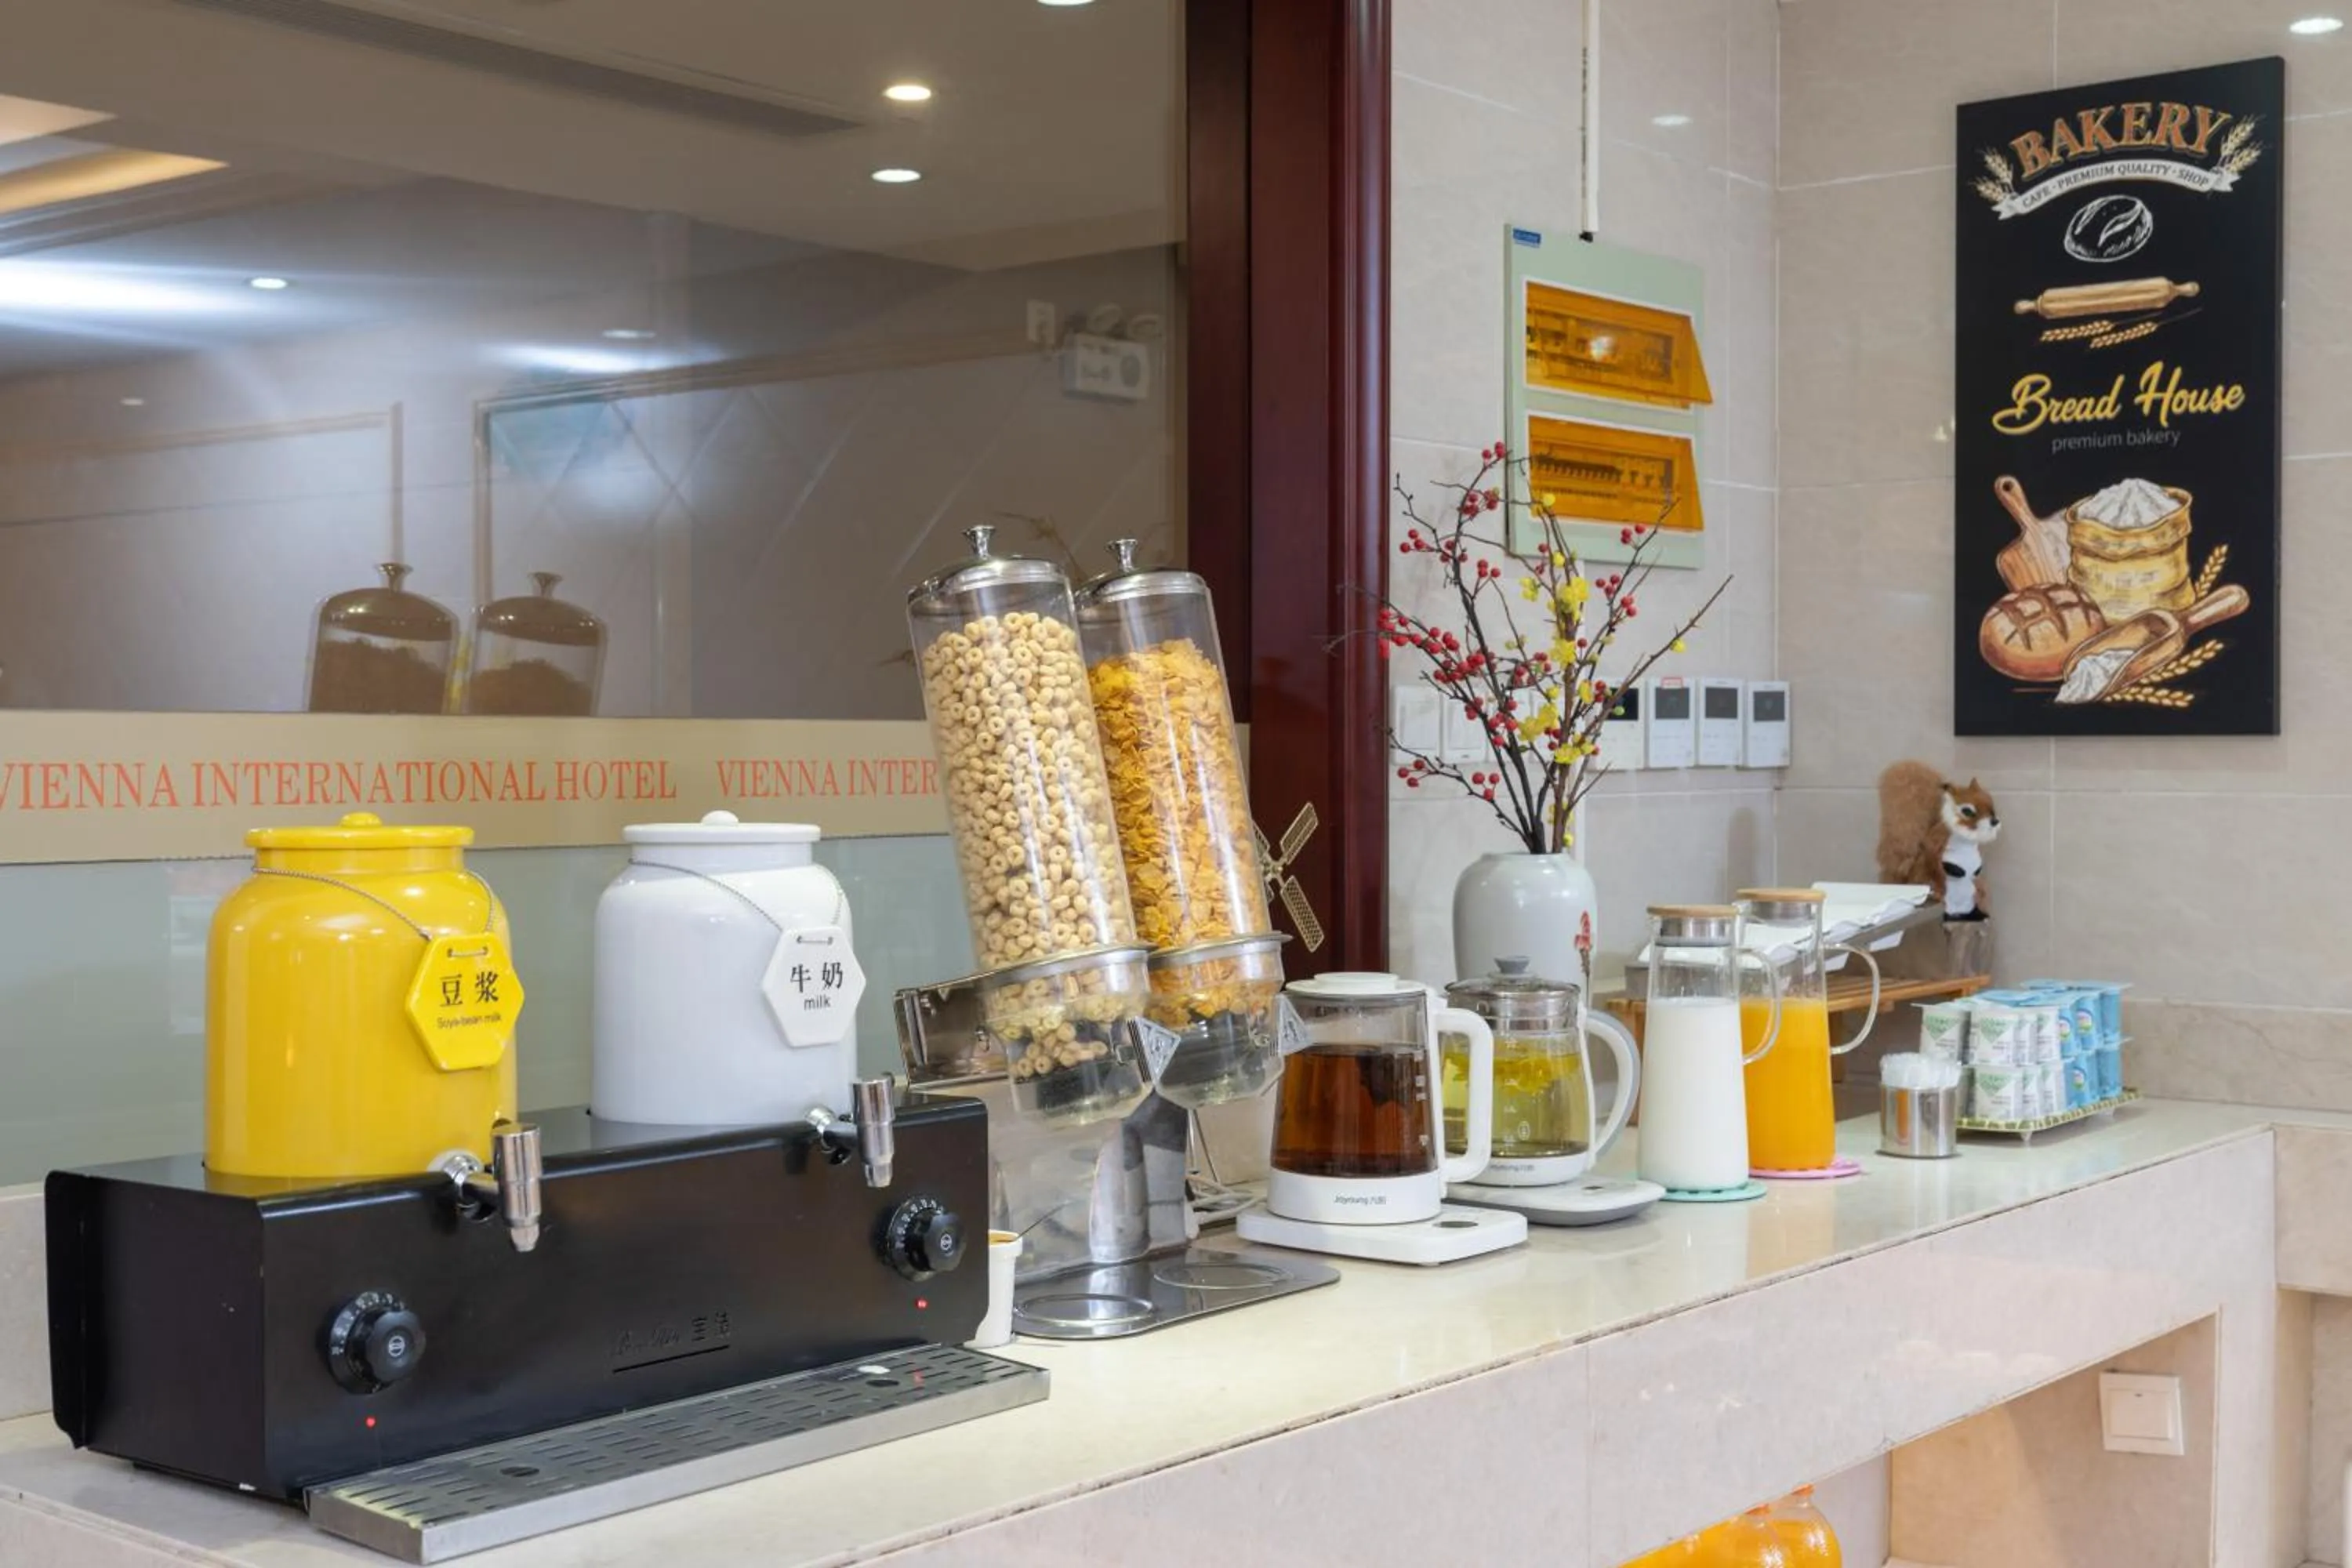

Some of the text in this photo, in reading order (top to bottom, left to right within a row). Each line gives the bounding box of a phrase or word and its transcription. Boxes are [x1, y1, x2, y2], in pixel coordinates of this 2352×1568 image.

[2009, 101, 2233, 180] BAKERY
[2022, 162, 2209, 208] CAFE PREMIUM QUALITY SHOP
[1992, 361, 2245, 435] Bread House
[2051, 426, 2182, 454] premium bakery
[191, 760, 546, 808] INTERNATIONAL
[554, 760, 677, 800] HOTEL
[717, 759, 840, 799] VIENNA
[439, 971, 499, 1007] 豆浆
[790, 962, 844, 993] 牛奶
[804, 994, 832, 1011] milk
